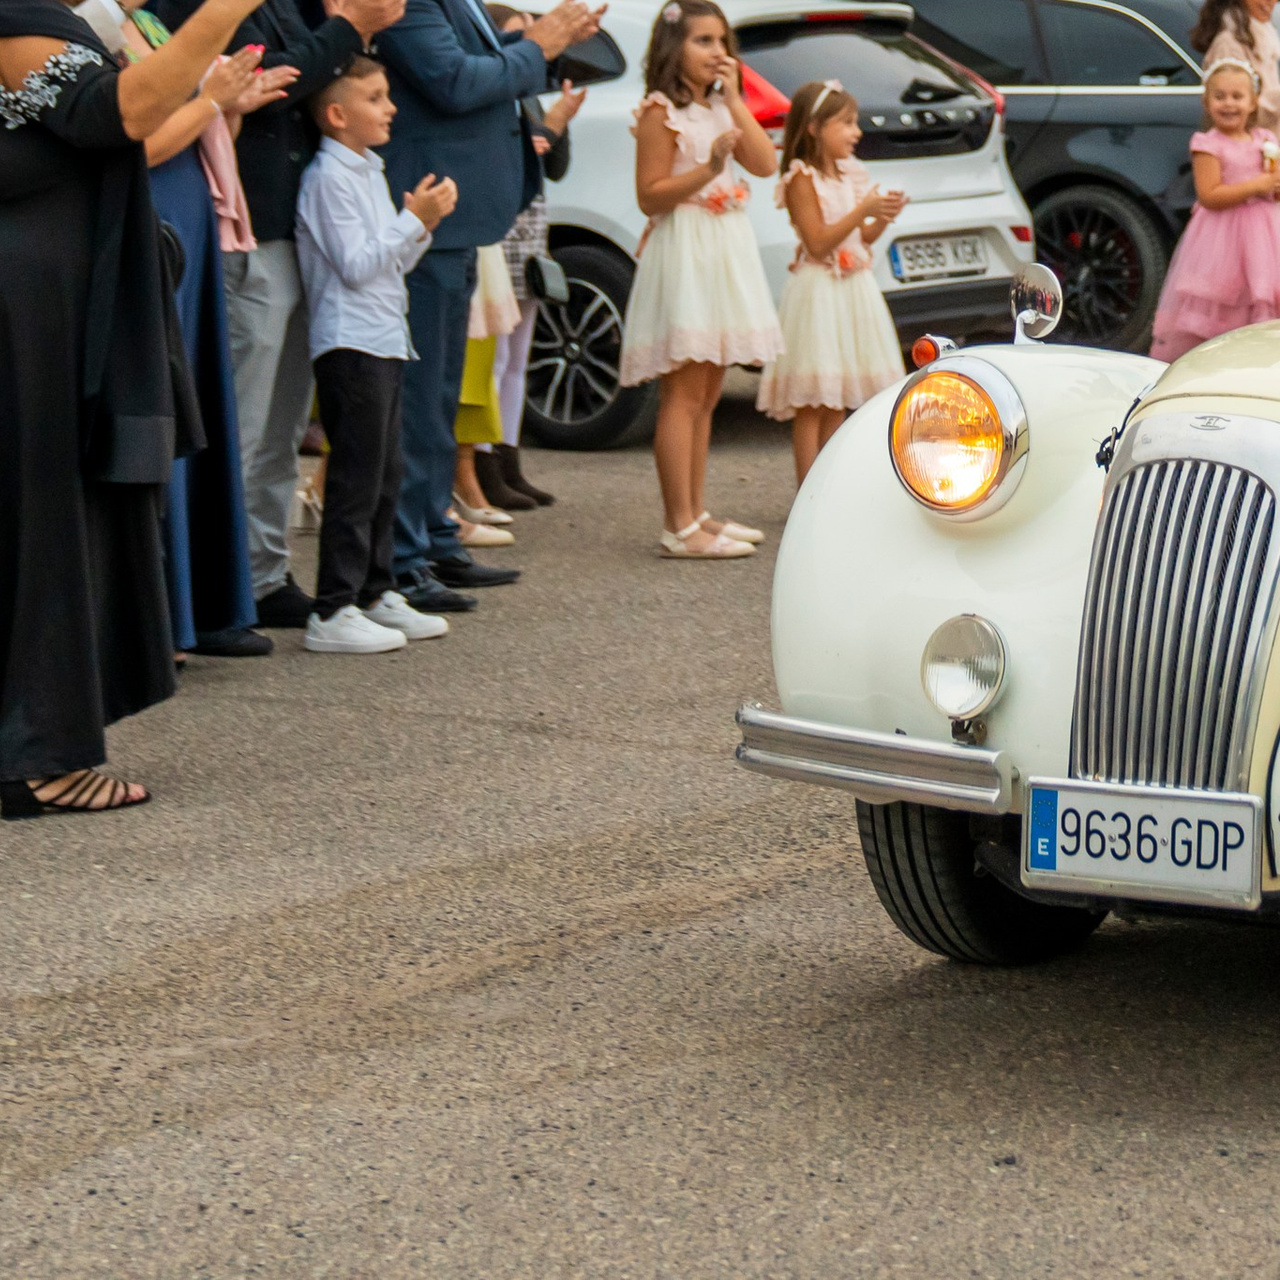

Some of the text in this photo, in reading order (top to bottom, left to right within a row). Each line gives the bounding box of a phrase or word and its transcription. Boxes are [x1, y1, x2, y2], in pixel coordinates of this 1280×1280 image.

[903, 241, 946, 270] 9696
[1037, 838, 1049, 855] E
[1060, 807, 1245, 871] 9636 GDP
